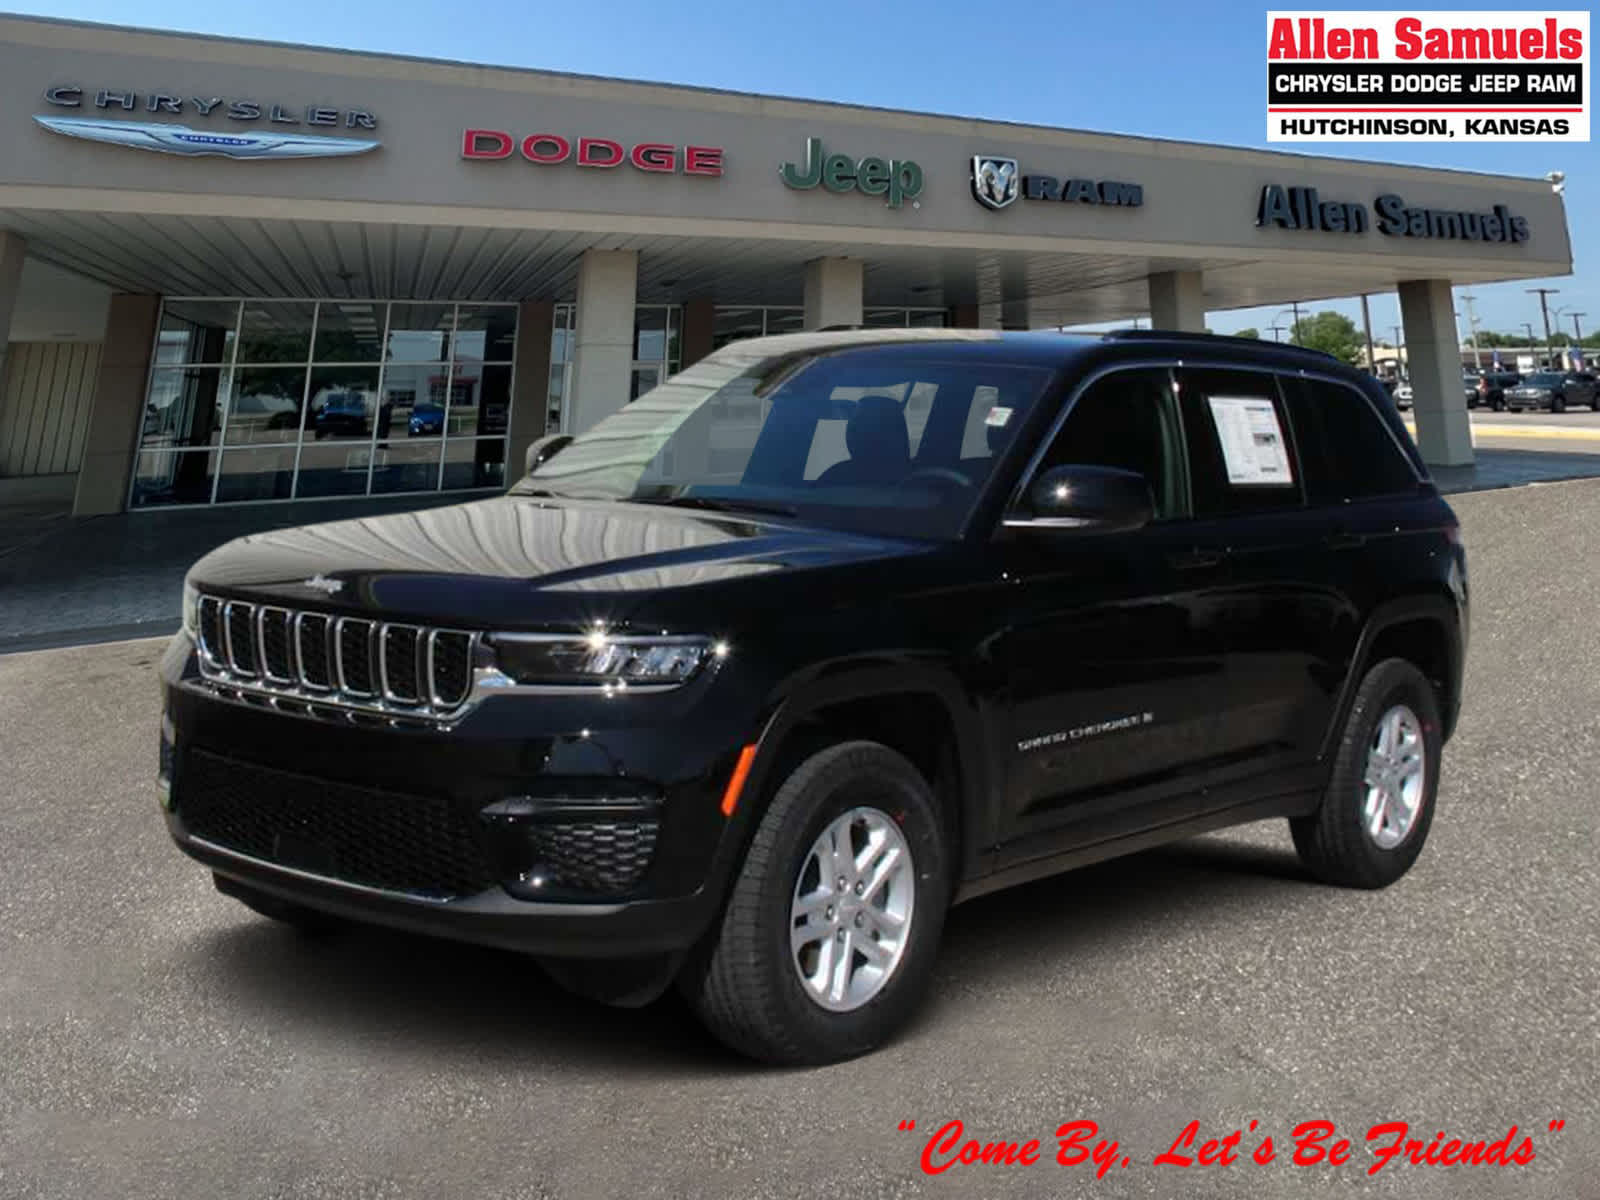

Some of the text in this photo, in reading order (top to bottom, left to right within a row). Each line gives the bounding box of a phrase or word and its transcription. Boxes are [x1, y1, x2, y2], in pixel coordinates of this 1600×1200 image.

[44, 86, 378, 129] CHRYSLER
[461, 128, 724, 177] DODGE
[779, 137, 923, 209] Jeep
[1022, 175, 1143, 206] RAM
[1256, 184, 1530, 243] Allen Samuels
